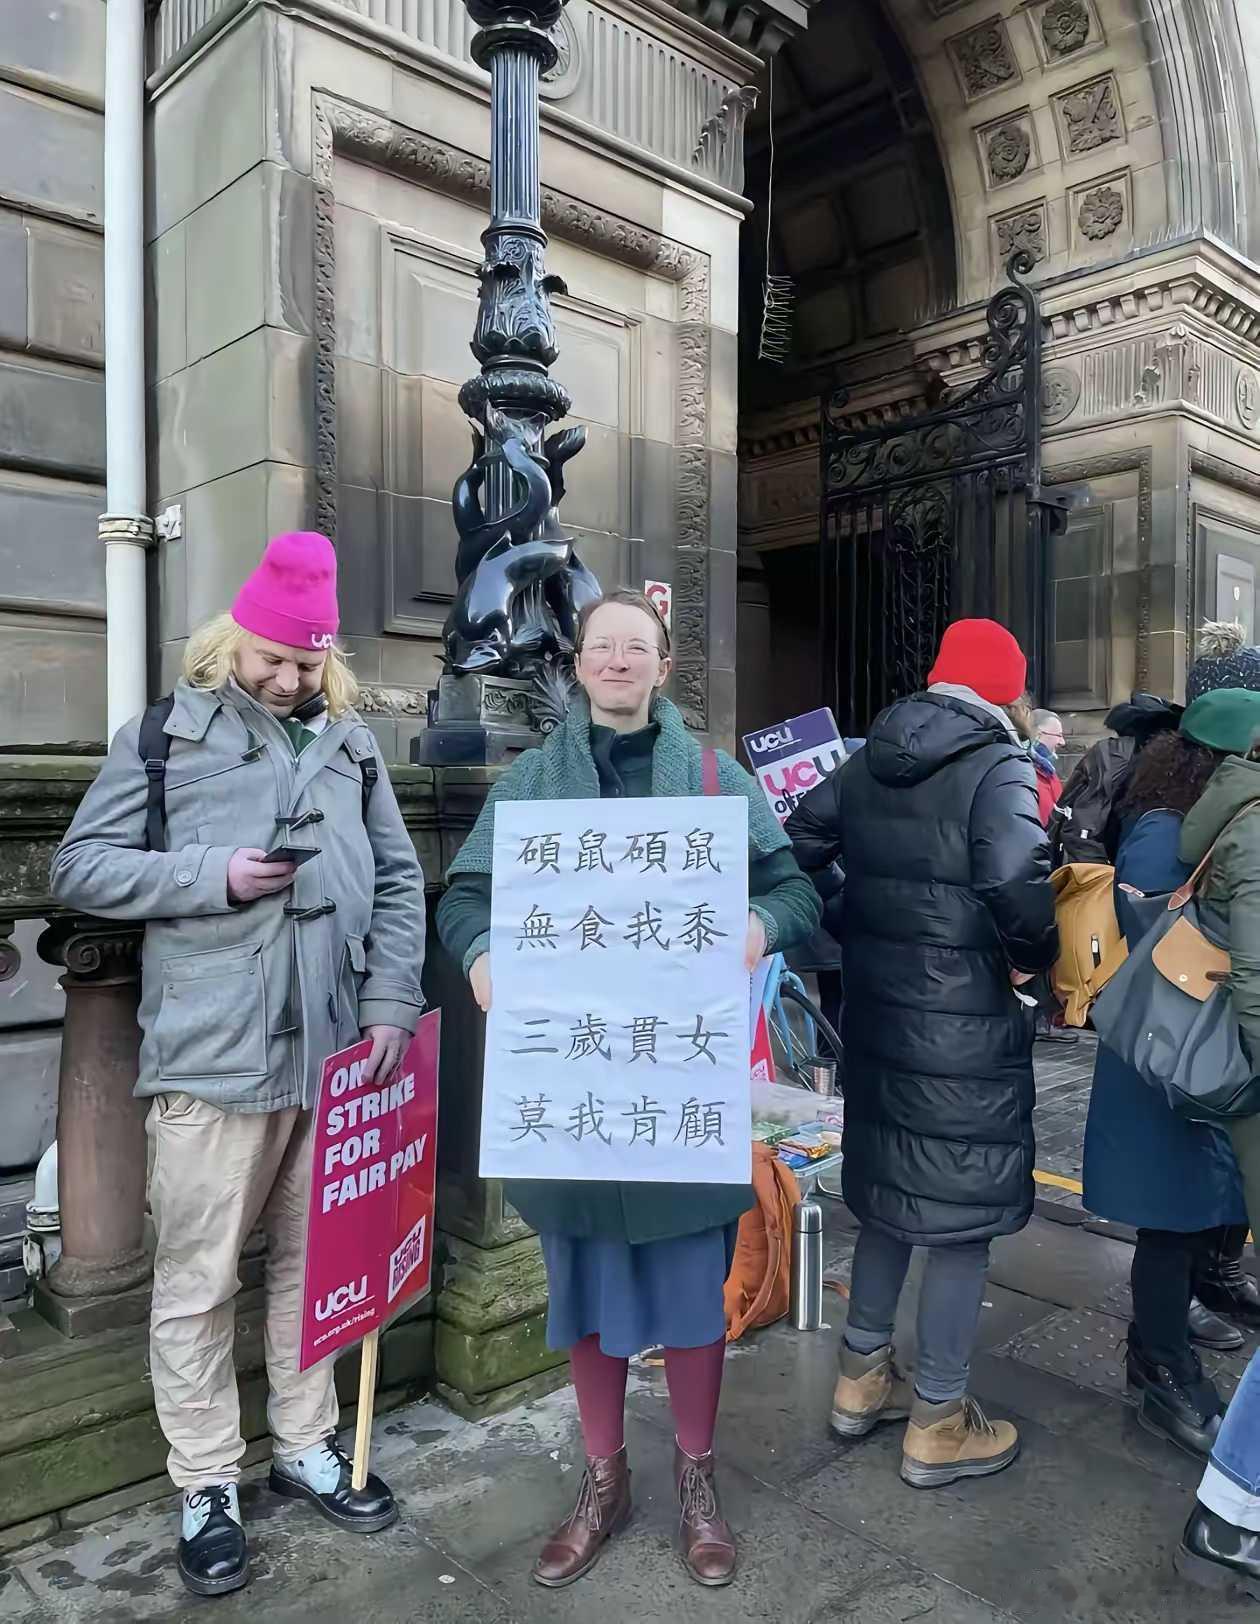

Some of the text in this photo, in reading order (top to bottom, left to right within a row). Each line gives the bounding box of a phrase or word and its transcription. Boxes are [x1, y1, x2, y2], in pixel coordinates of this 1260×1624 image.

[750, 726, 794, 752] UCU
[763, 749, 841, 797] UCU
[517, 828, 722, 874] 碩鼠碩鼠
[515, 901, 729, 952] 無食我黍
[509, 1013, 729, 1065] 三歲貫女
[326, 1072, 415, 1136] STRIKE
[508, 1091, 726, 1149] 莫我肯顧
[322, 1132, 428, 1214] FAIR PAY
[324, 1127, 381, 1176] FOR
[315, 1274, 368, 1321] UCU
